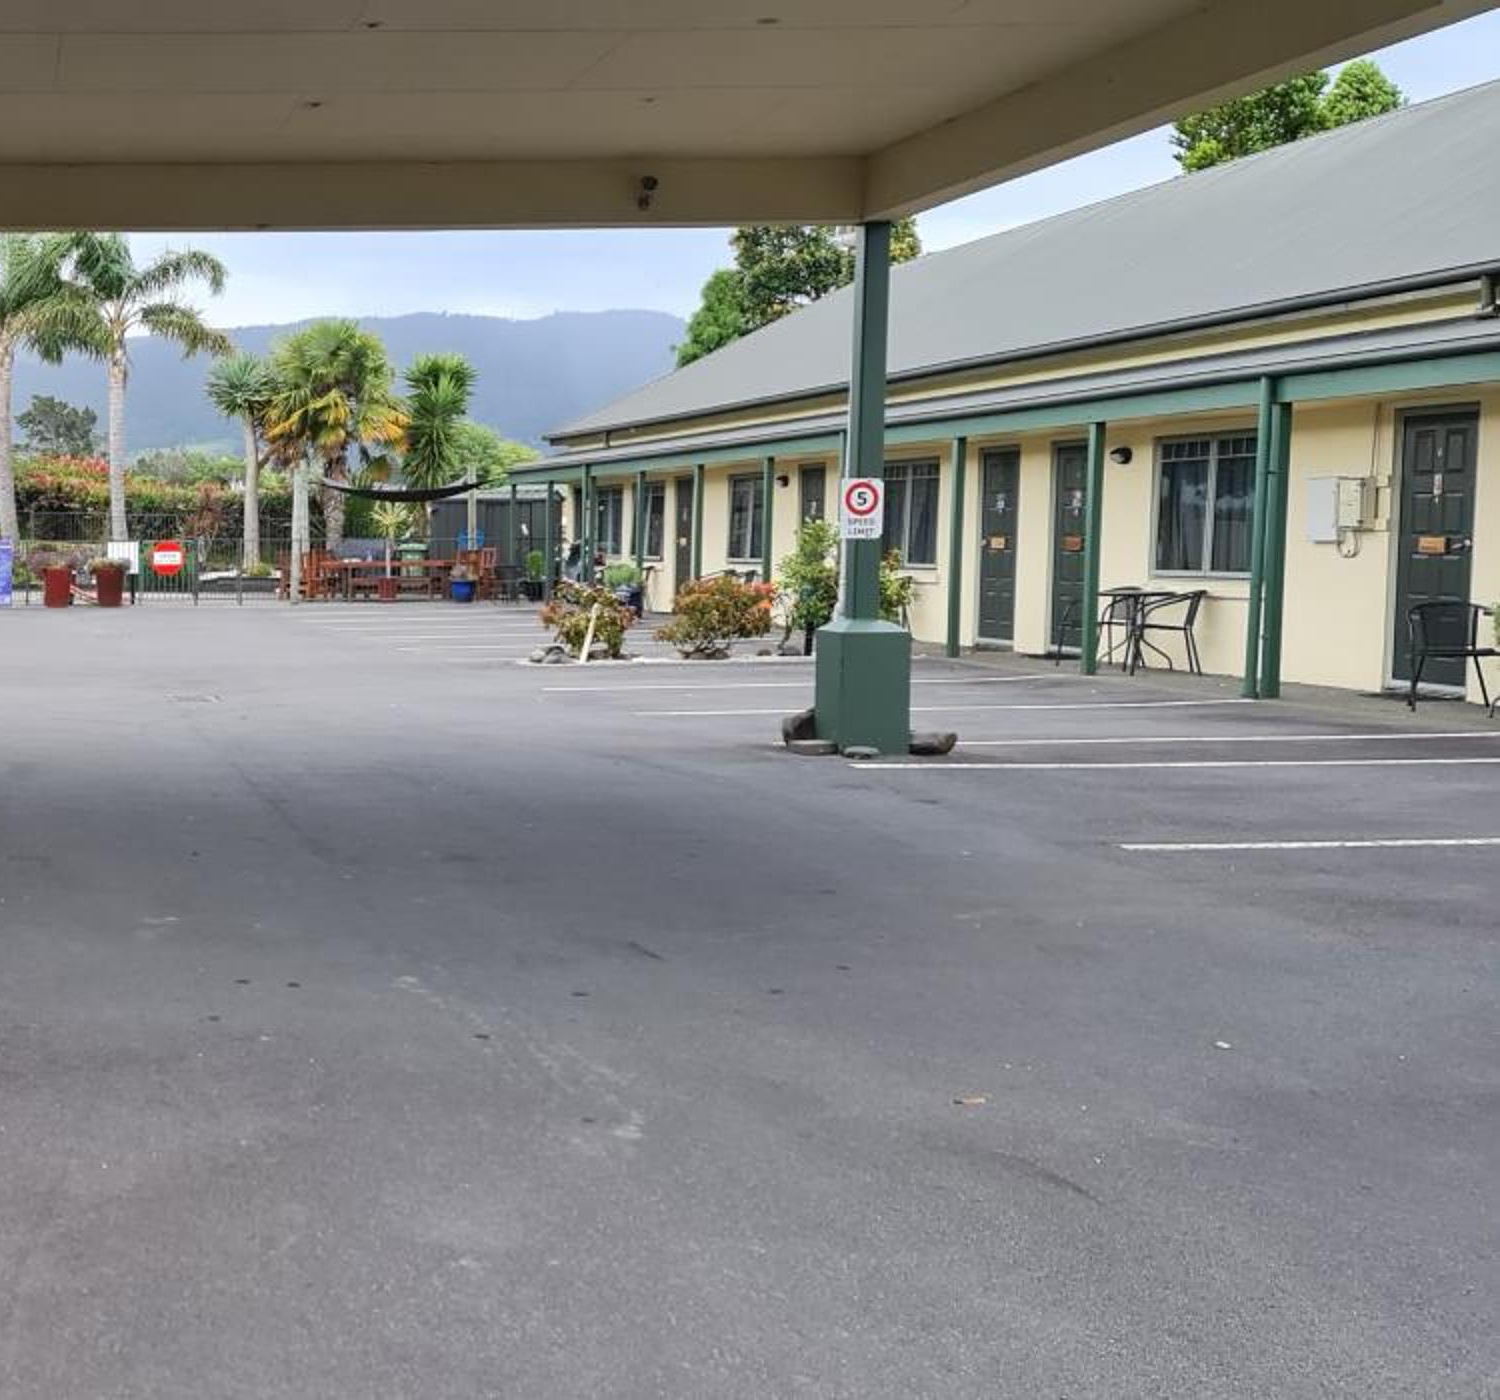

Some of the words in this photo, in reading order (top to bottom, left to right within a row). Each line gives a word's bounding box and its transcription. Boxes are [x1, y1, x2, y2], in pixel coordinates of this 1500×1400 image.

[856, 491, 868, 506] 5
[847, 518, 875, 526] SPEED
[847, 527, 876, 536] LIMIT
